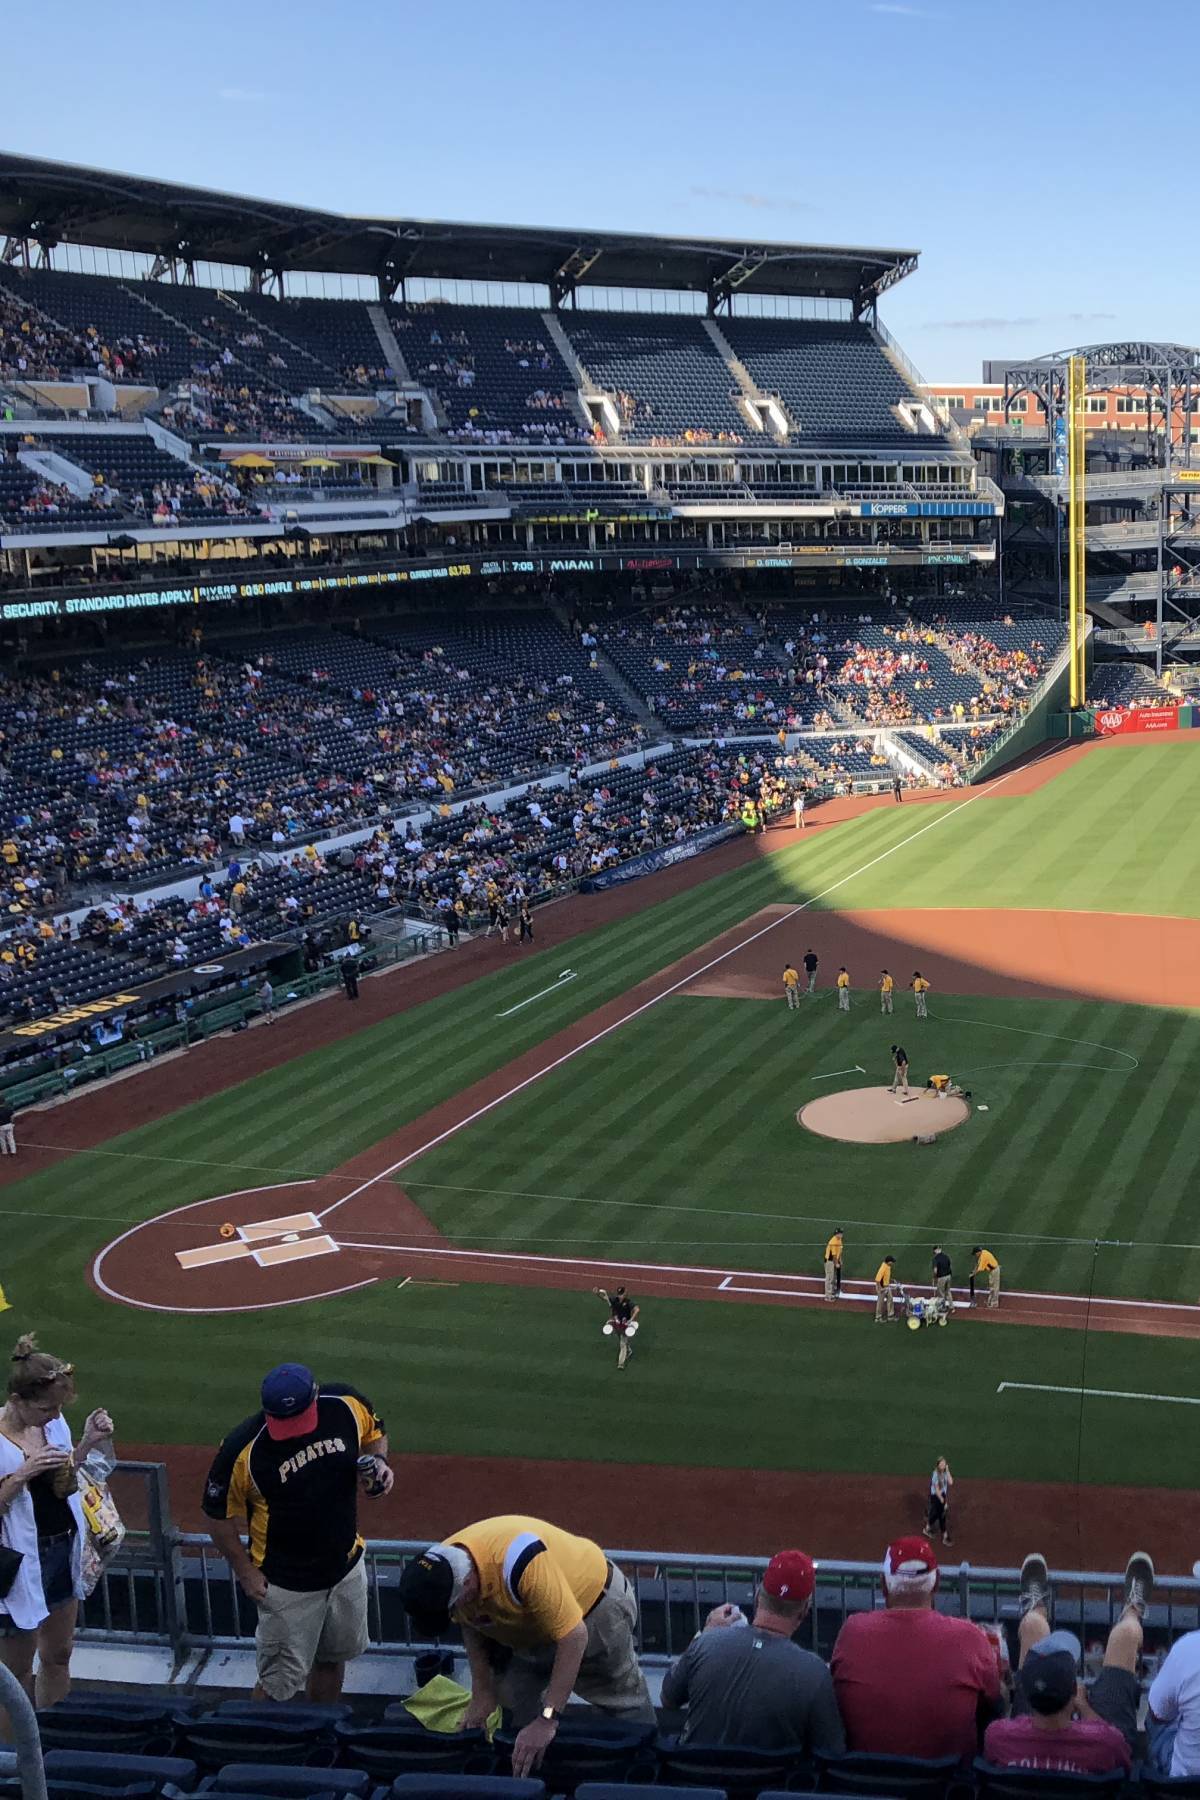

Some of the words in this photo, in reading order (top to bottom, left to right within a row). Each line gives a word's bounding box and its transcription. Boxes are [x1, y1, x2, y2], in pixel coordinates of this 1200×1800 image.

[871, 503, 908, 514] KOPPERS
[512, 561, 533, 571] 7:05
[551, 560, 594, 570] MIAMI
[765, 559, 792, 567] STRAILY
[854, 558, 888, 566] GONZALEZ
[200, 584, 237, 596] RIVERS
[264, 581, 292, 594] RAFFLE
[4, 602, 62, 619] SECURITY.
[66, 596, 126, 614] STANDARD
[126, 592, 158, 607] RATES
[160, 590, 194, 604] APPLY.
[1102, 714, 1120, 726] AAA
[278, 1438, 346, 1484] PIRATES
